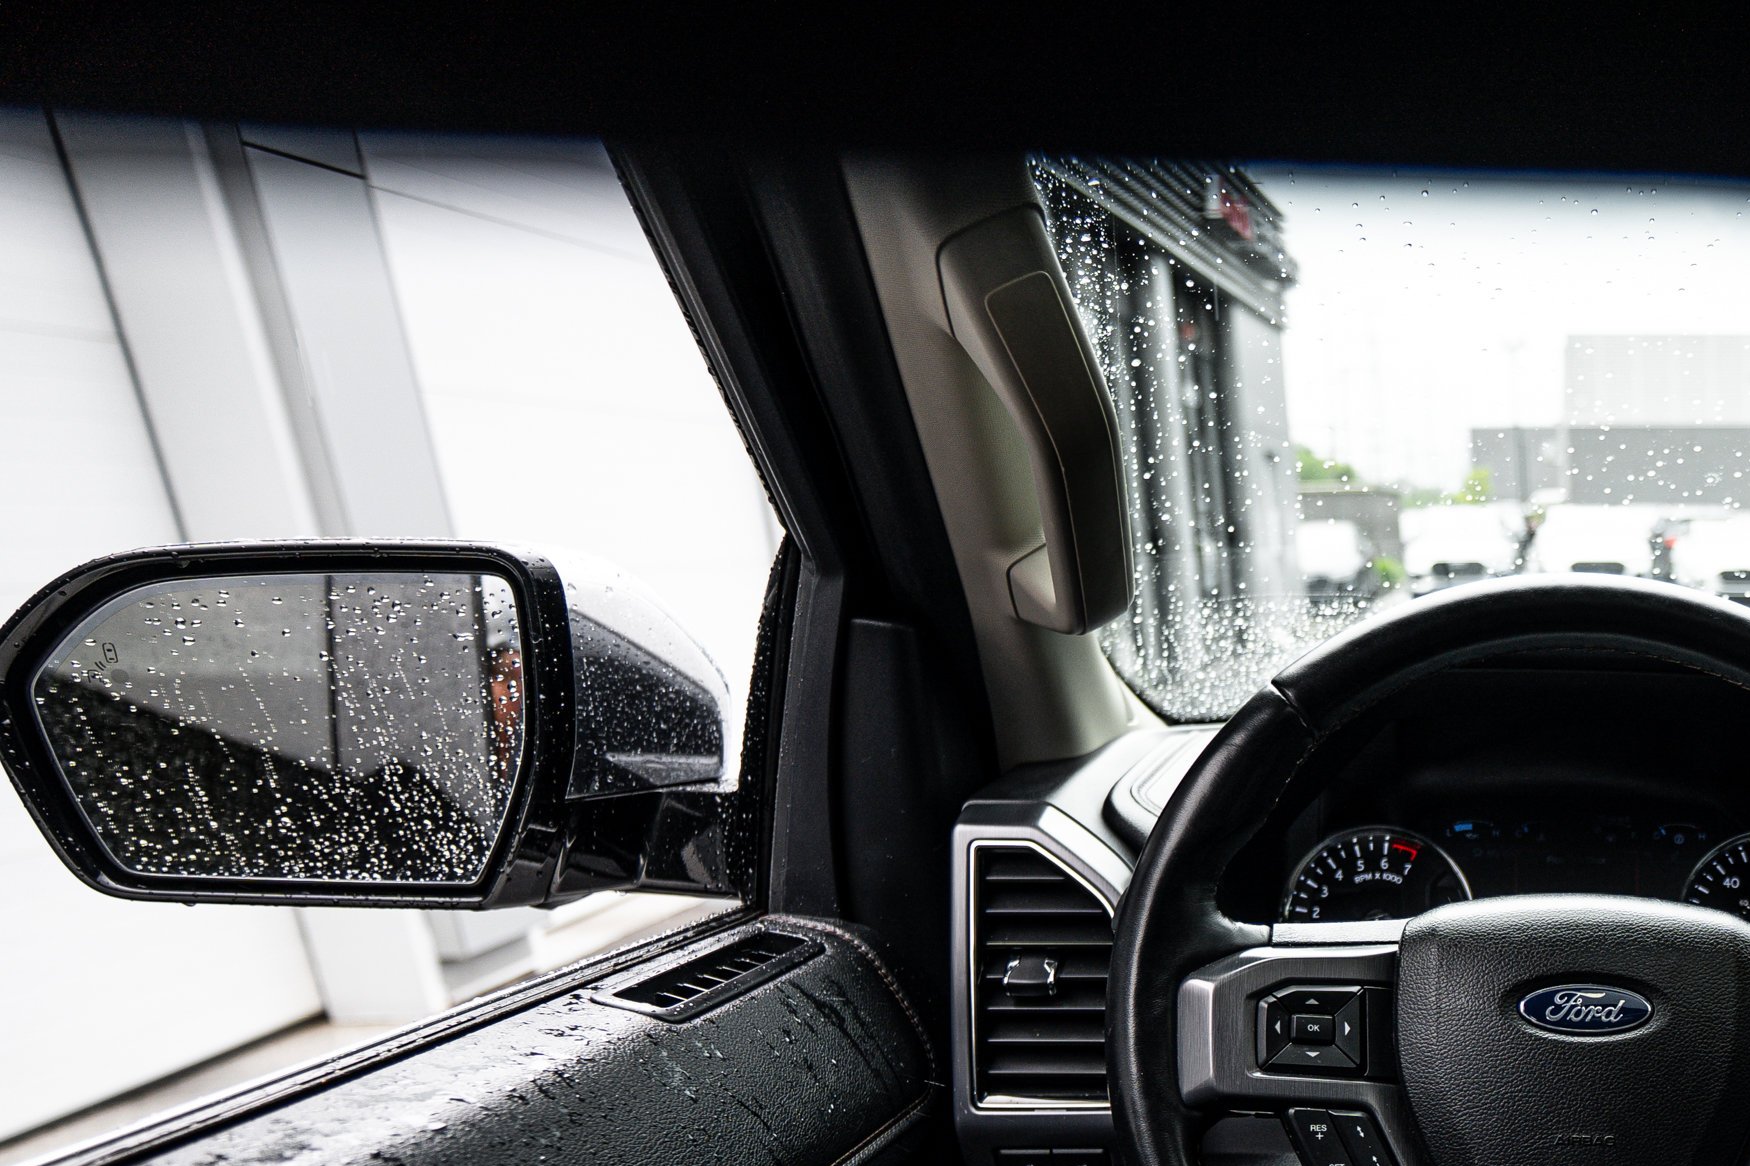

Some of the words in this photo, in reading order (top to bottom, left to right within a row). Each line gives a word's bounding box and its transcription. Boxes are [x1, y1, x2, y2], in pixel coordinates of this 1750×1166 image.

[1356, 859, 1366, 872] 5
[1379, 857, 1390, 870] 6
[1402, 863, 1413, 876] 7
[1333, 868, 1344, 881] 4
[1353, 873, 1373, 885] RPM
[1382, 872, 1404, 885] 1000
[1722, 876, 1741, 889] 40
[1319, 885, 1330, 898] 3
[1311, 906, 1321, 919] 2
[1545, 990, 1626, 1024] Ford
[1307, 1024, 1320, 1032] OK
[1309, 1124, 1328, 1132] RES
